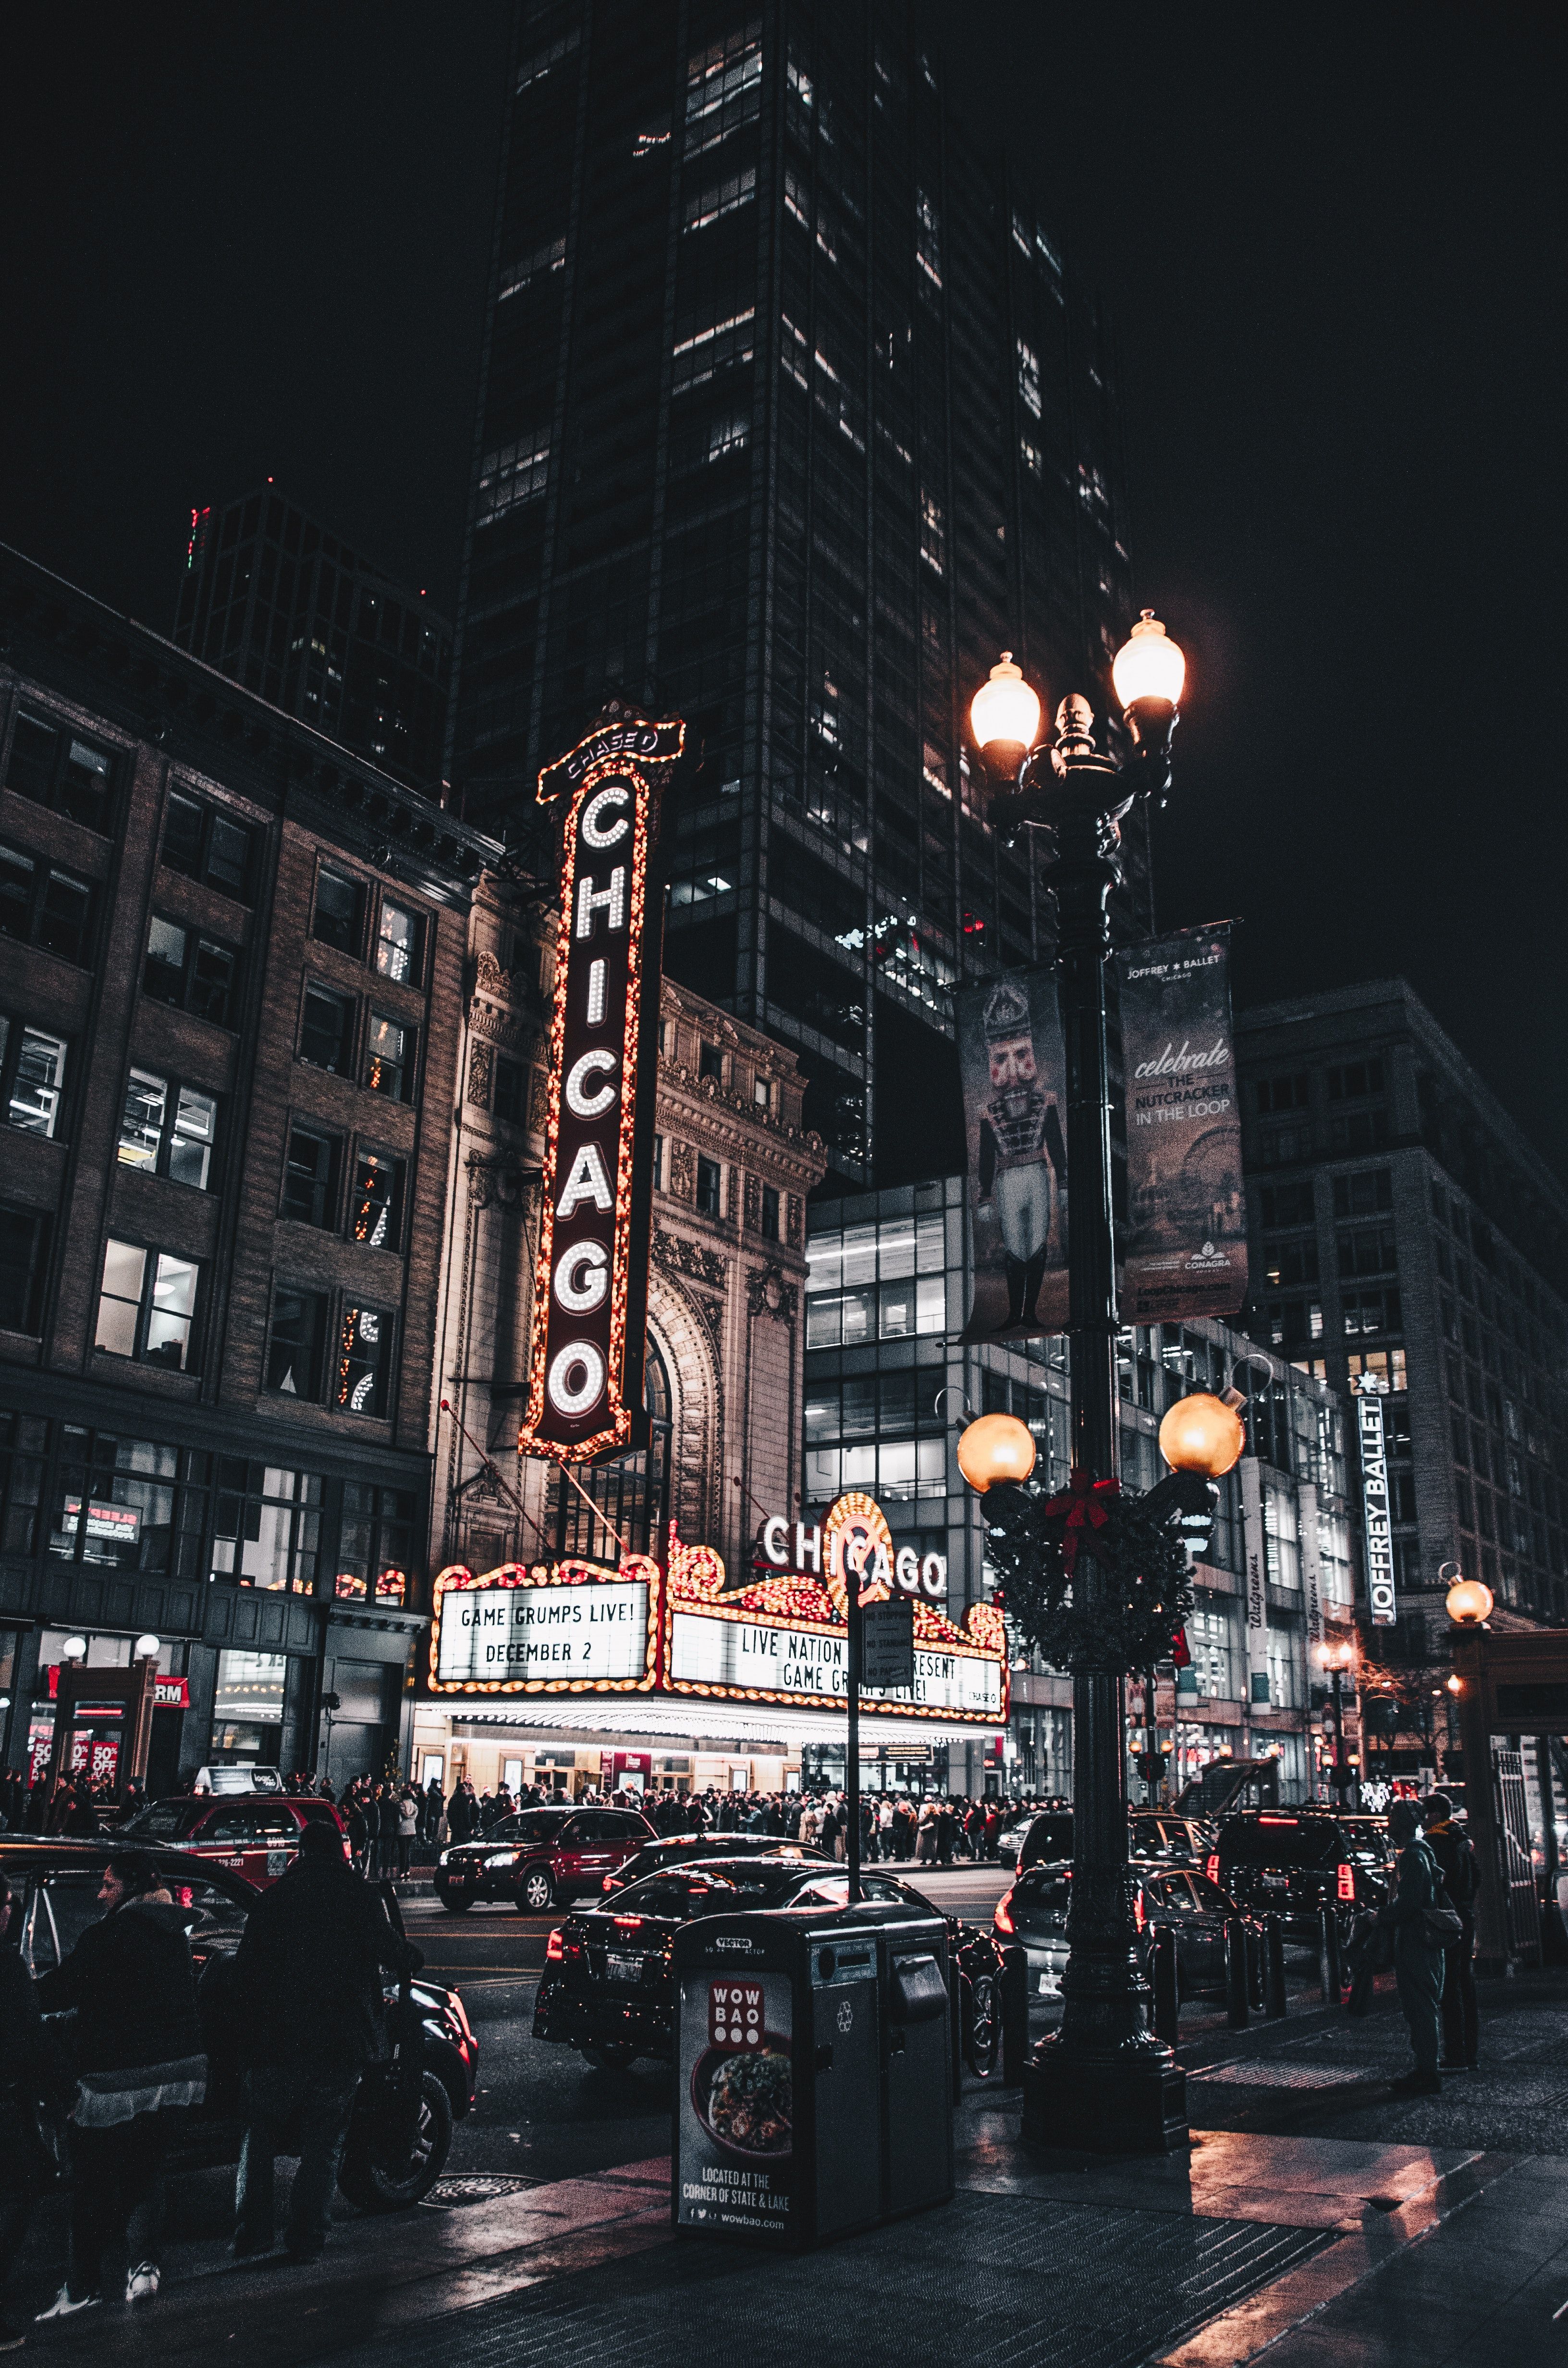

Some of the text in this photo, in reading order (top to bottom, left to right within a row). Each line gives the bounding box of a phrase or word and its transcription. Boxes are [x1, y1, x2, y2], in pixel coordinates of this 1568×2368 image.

[568, 731, 638, 779] CHASE
[1127, 954, 1220, 980] JOFFREY BALLET
[1161, 972, 1192, 982] CHICAGO
[1134, 1038, 1229, 1079] celebrate
[1168, 1073, 1195, 1087] THE
[549, 787, 629, 1415] CHICAGO
[1135, 1084, 1229, 1109] NUTCRACKER
[1136, 1098, 1230, 1126] IN THE LOOP
[1184, 1259, 1231, 1270] CONAGRA
[1138, 1283, 1231, 1296] LoopChicago.com
[1360, 1400, 1394, 1623] JOFFREY BALLET
[764, 1515, 946, 1596] CHICAGO
[1250, 1553, 1264, 1629] Walgreens
[462, 1603, 634, 1627] GAME GRUMPS LIVE!
[486, 1642, 592, 1662] DECEMBER 2
[742, 1628, 955, 1679] LIVE NATION RESENT
[784, 1663, 823, 1690] GAME
[155, 1684, 182, 1702] RM
[93, 1746, 118, 1760] 50%
[92, 1760, 117, 1771] OFF
[719, 1938, 750, 1948] VECTOR
[713, 1988, 760, 2005] WOW
[715, 2007, 759, 2024] BAO
[702, 2167, 770, 2190] LOCATED AT THE
[682, 2183, 790, 2211] CORNER OF STATE & LAKE
[721, 2213, 785, 2230] wowbao.com
